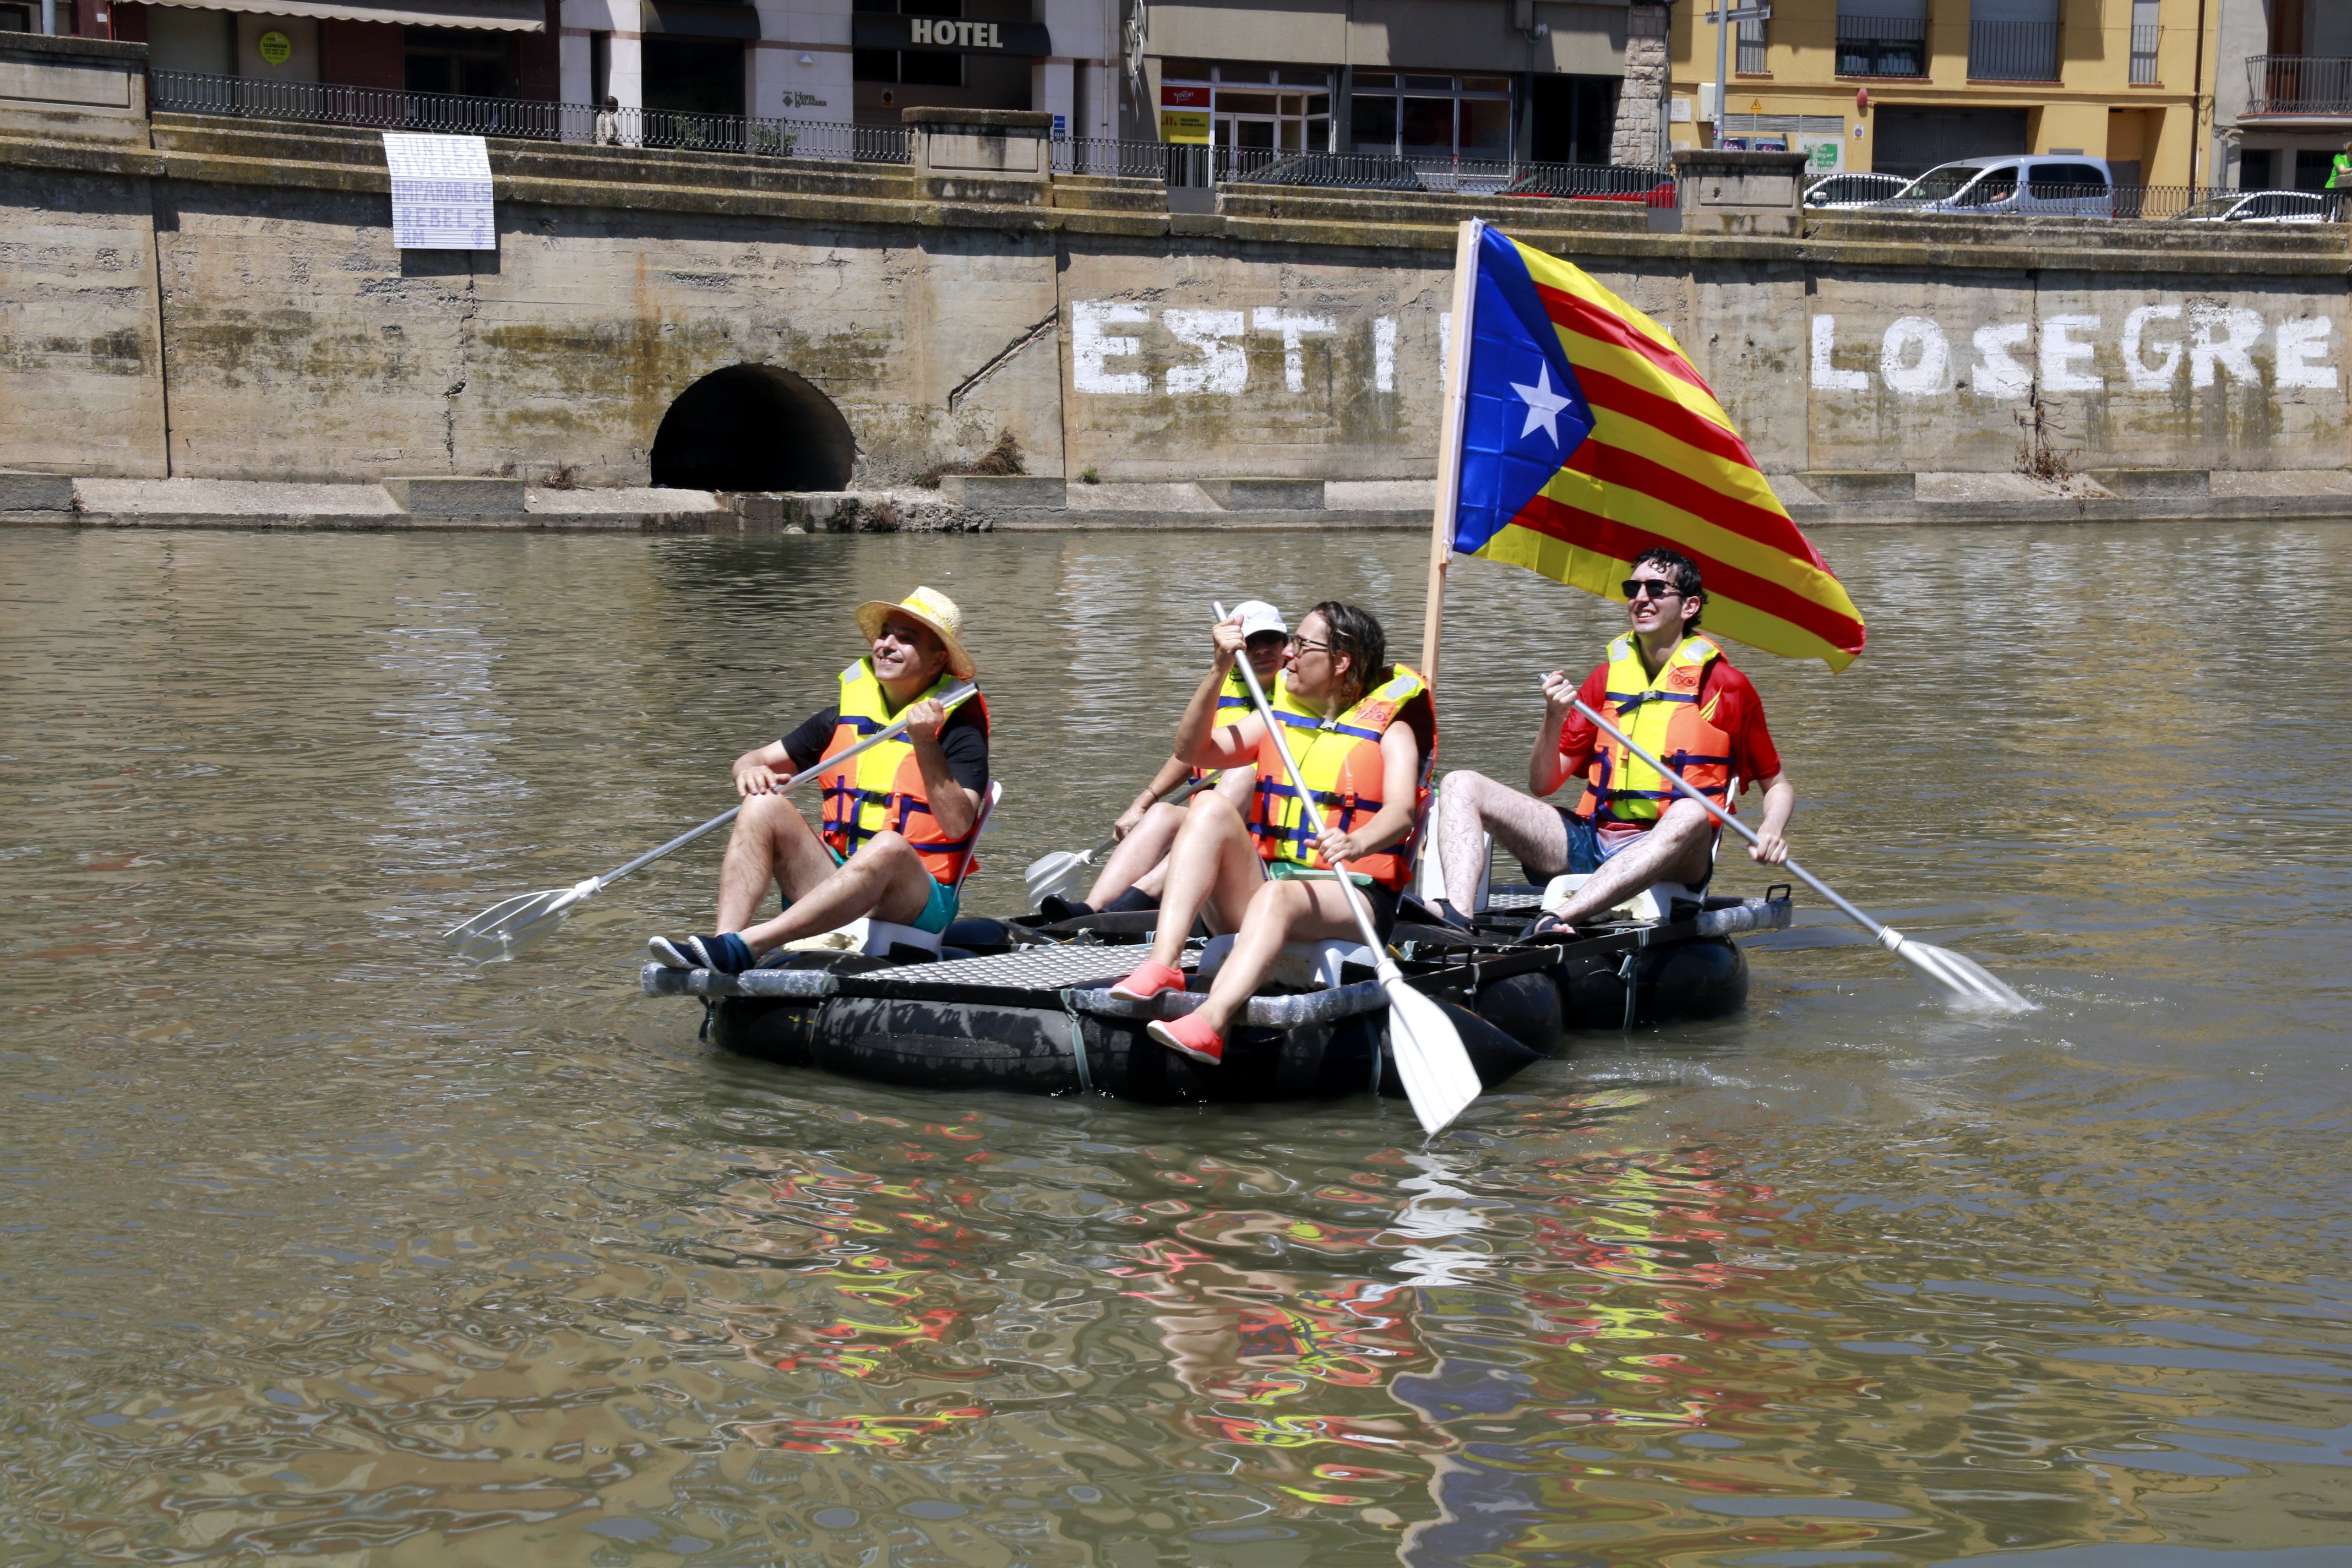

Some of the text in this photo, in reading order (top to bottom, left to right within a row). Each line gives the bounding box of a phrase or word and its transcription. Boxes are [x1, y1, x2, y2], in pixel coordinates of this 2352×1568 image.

[911, 19, 1003, 48] HOTEL
[395, 138, 477, 157] JUNTES
[390, 156, 489, 177] DIVERSES
[394, 181, 491, 203] IMPARABLES
[402, 228, 426, 247] 8M
[1072, 298, 1452, 396] ESTI
